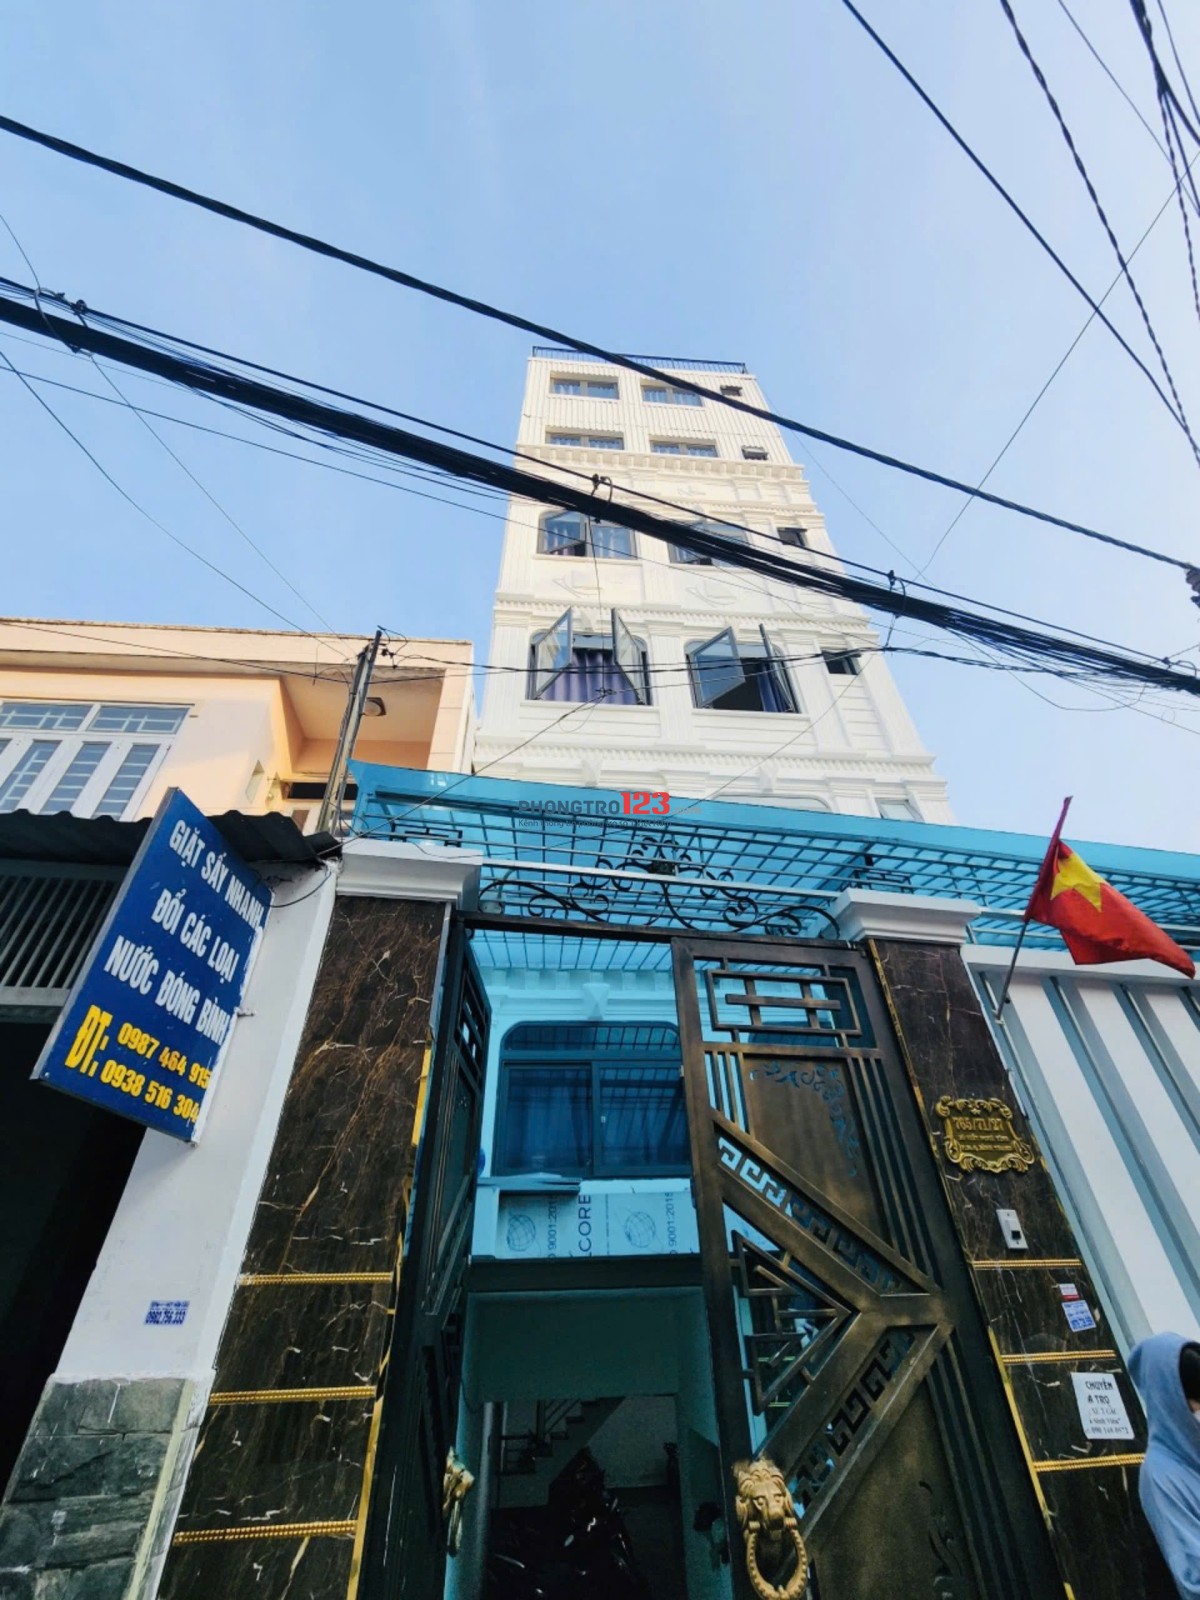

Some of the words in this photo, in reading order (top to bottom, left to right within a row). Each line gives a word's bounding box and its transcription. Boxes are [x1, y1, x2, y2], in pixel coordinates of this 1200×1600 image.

[169, 819, 206, 868] GIẶT
[201, 851, 230, 894] SẤY
[224, 874, 265, 930] NHANH
[151, 888, 187, 936] ĐỔI
[180, 912, 212, 958] CÁC
[207, 935, 240, 984] LOẠI
[103, 935, 160, 995] NƯỚC
[154, 969, 201, 1025] ĐÓNG
[195, 996, 231, 1046] BÌNH
[100, 1059, 146, 1097] 0938
[144, 1080, 173, 1109] 516
[173, 1094, 200, 1123] 304
[117, 1022, 160, 1059] 0987
[158, 1046, 187, 1076] 464
[188, 1062, 212, 1089] 915
